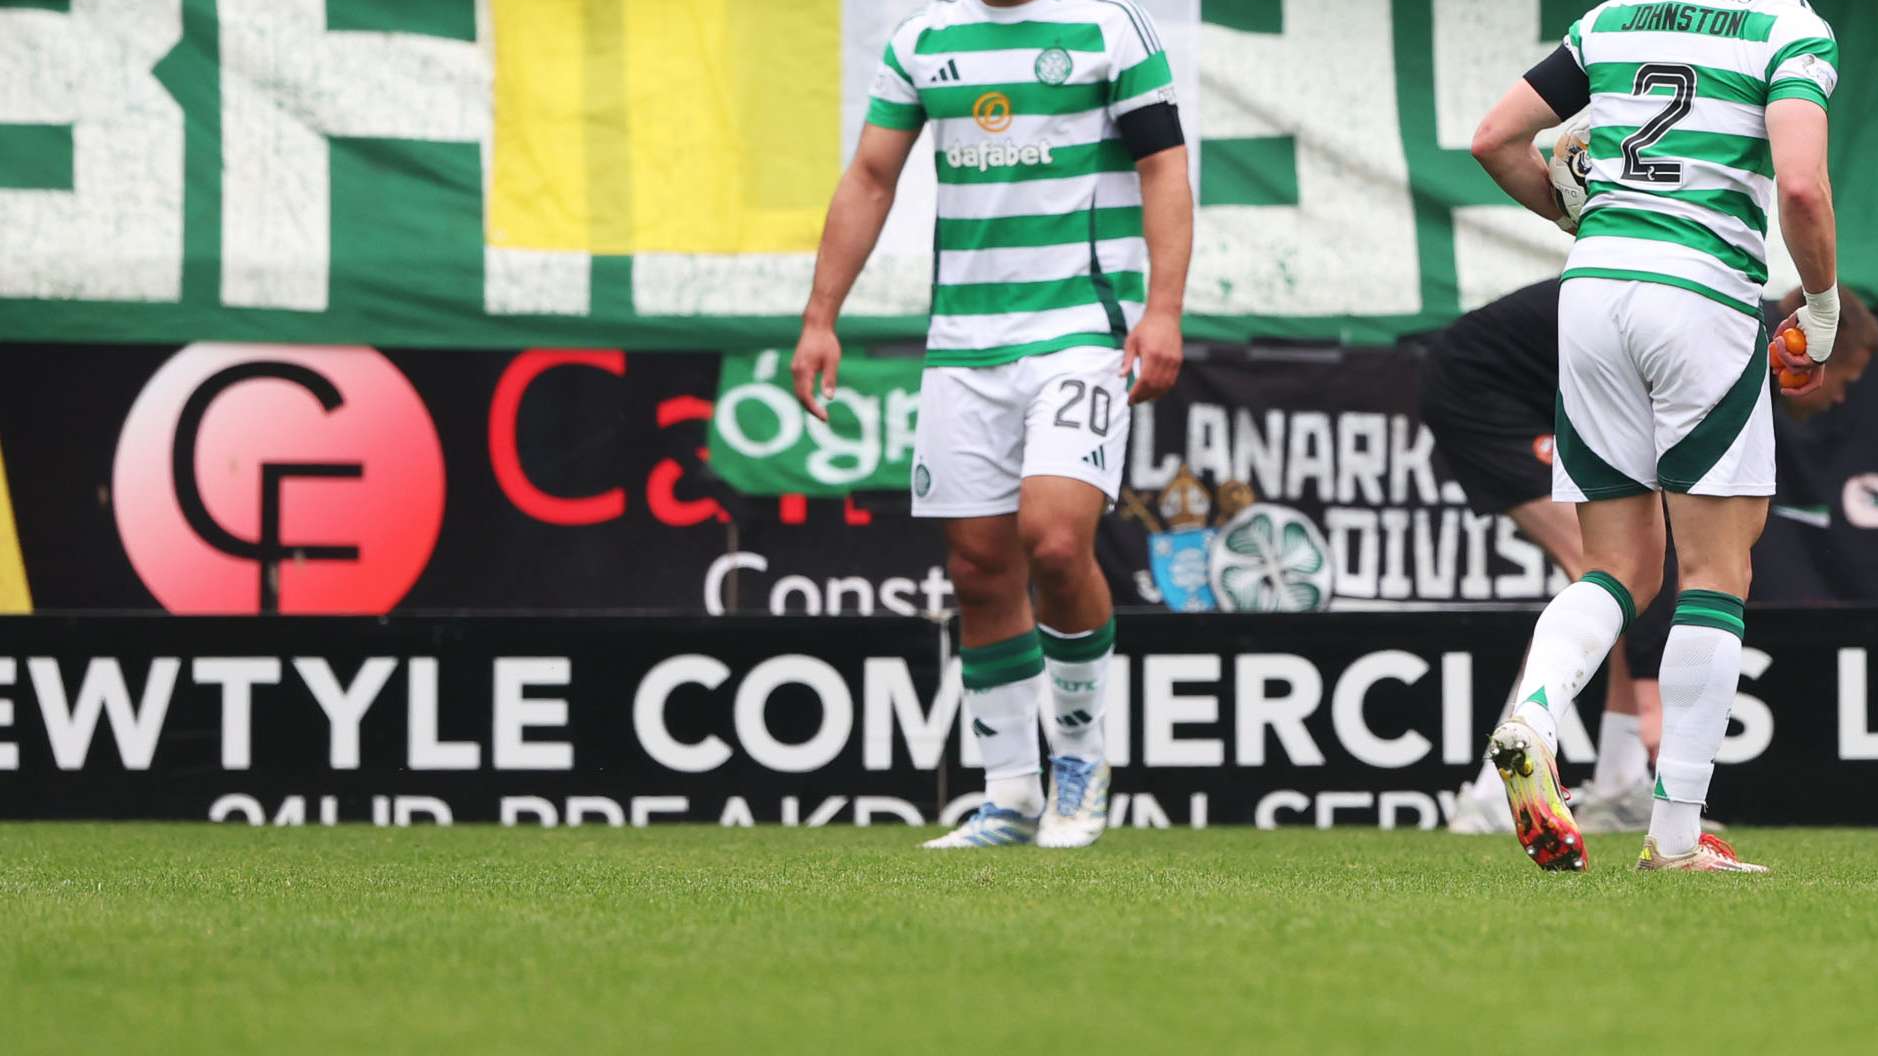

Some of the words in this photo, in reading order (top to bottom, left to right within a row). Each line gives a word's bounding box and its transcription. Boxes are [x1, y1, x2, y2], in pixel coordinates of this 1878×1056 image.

[1621, 1, 1744, 37] JOHNSTON
[947, 140, 1053, 171] dafabet
[1620, 62, 1697, 183] 2
[1053, 379, 1111, 437] 20
[1128, 399, 1467, 504] LANARK
[1325, 506, 1570, 603] DIVIS
[0, 656, 575, 771] WTYLE
